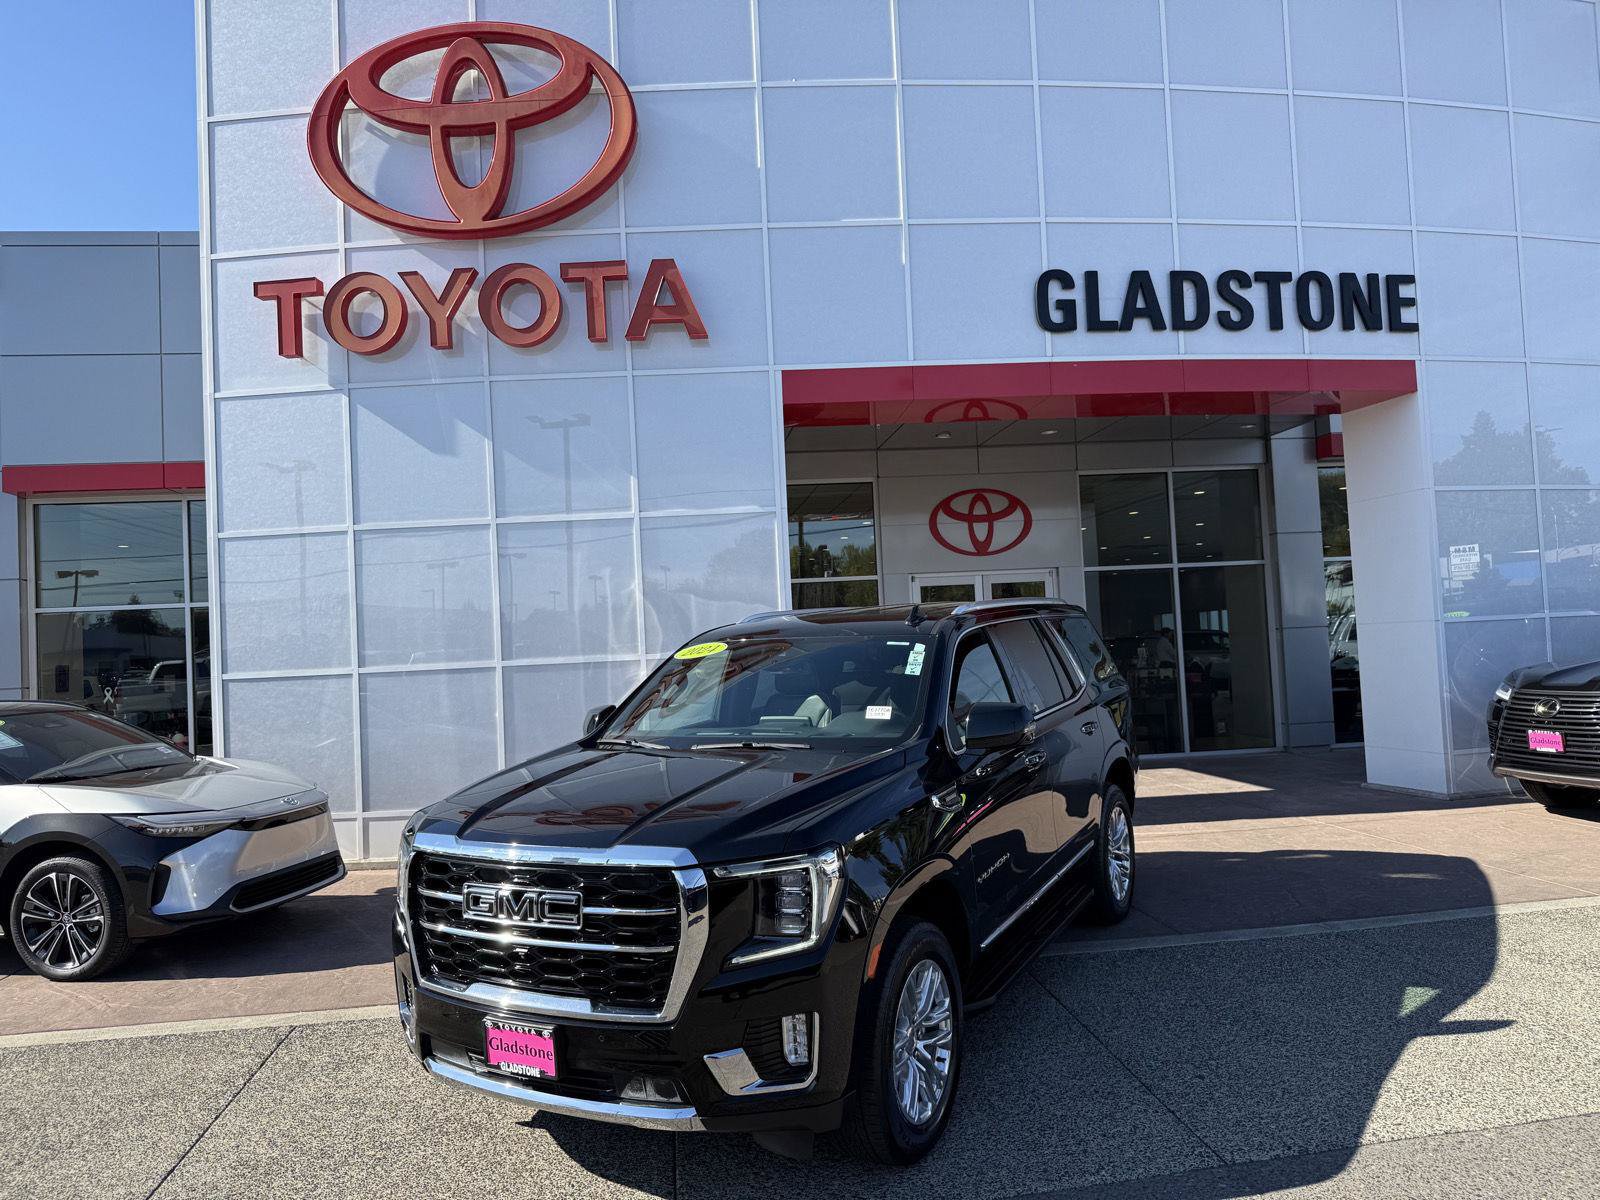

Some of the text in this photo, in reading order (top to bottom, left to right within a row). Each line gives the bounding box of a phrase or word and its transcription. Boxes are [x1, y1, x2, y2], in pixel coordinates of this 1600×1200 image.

[253, 258, 708, 359] TOYOTA
[1035, 269, 1419, 333] GLADSTONE
[1530, 737, 1561, 746] Gladstone
[977, 852, 1010, 884] YUKON
[463, 884, 582, 927] GMC
[498, 1022, 537, 1035] TOYOTA
[488, 1036, 554, 1061] Gladstone
[500, 1061, 541, 1078] GLADSTONE
